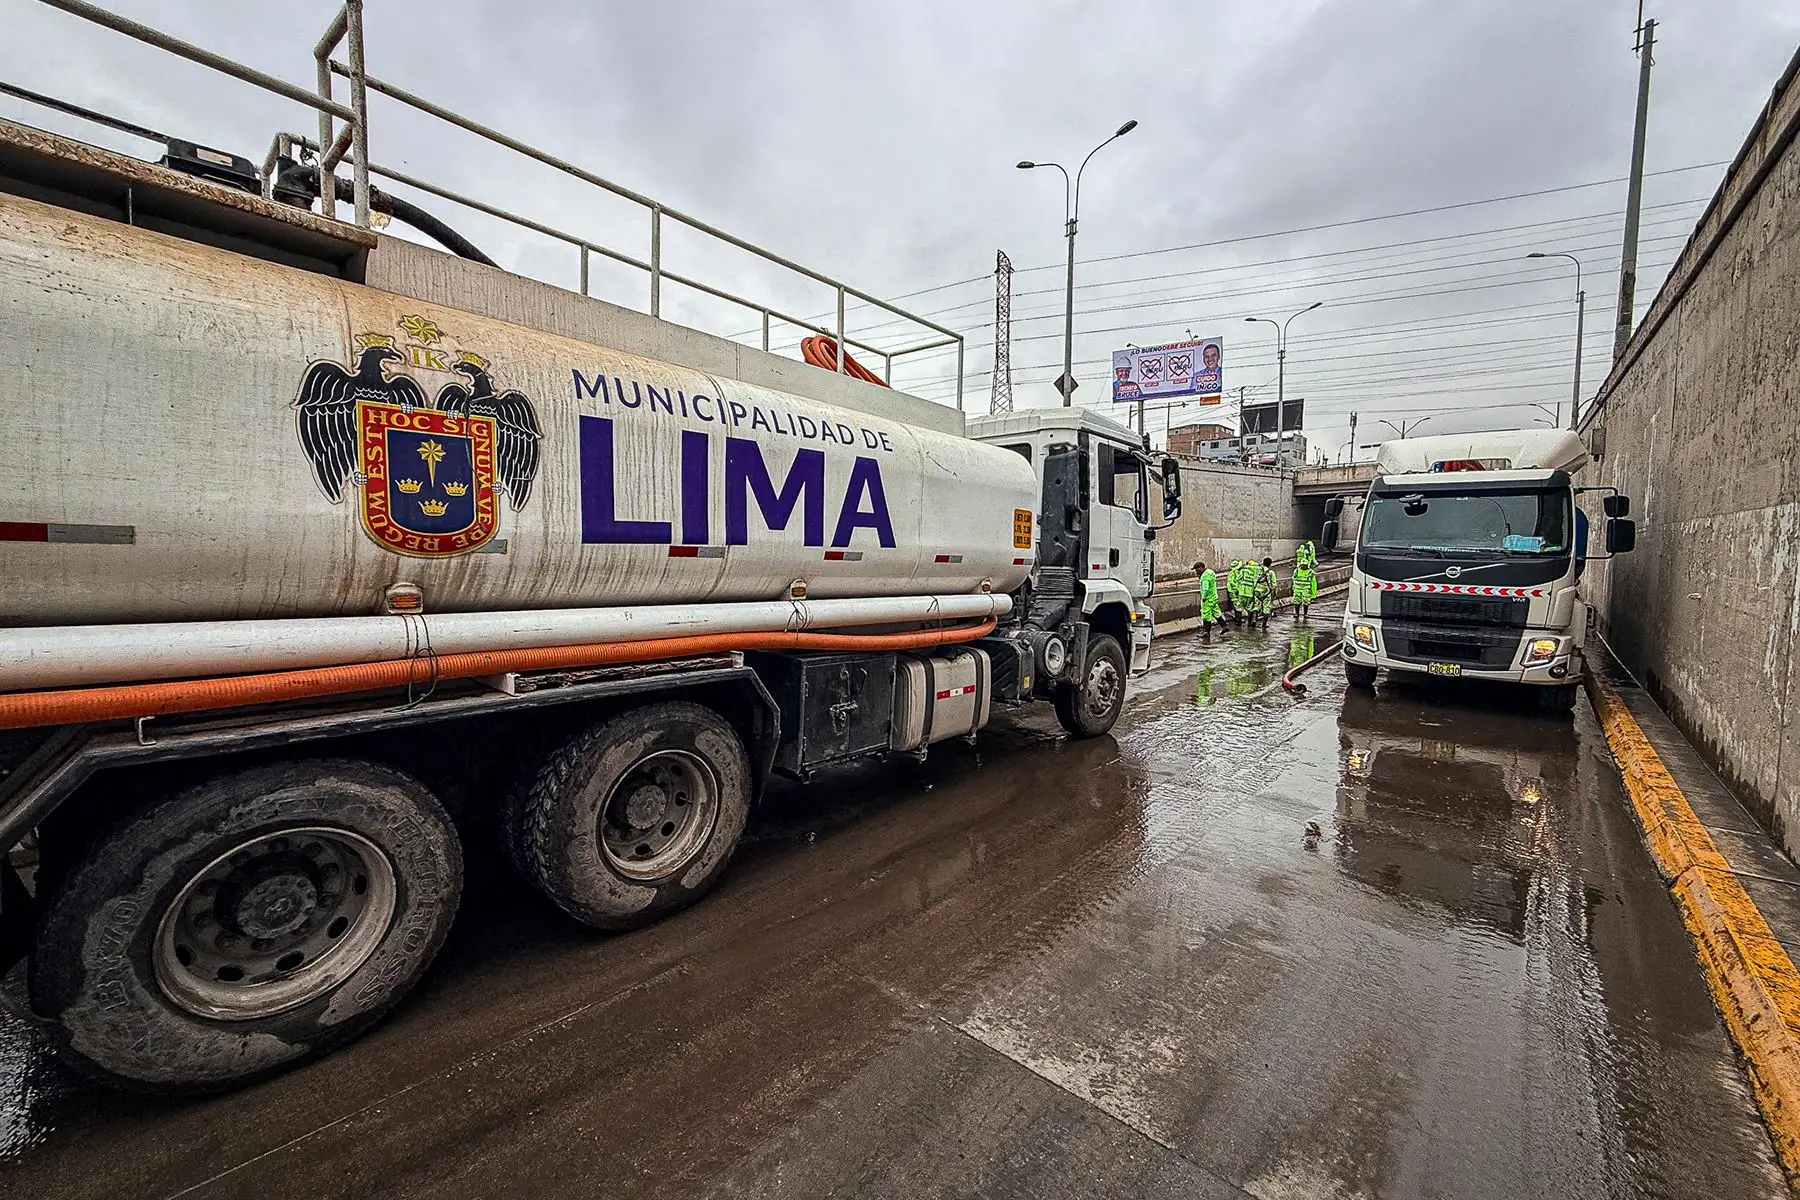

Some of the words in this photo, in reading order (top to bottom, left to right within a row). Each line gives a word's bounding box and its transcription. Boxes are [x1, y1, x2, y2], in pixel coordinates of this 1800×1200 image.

[409, 346, 447, 371] IK
[367, 408, 431, 430] HOC
[572, 368, 855, 446] MUNICIPALIDAD
[863, 427, 894, 452] DE
[365, 426, 384, 480] EST
[578, 414, 897, 549] LIMA
[368, 490, 440, 551] REGUM
